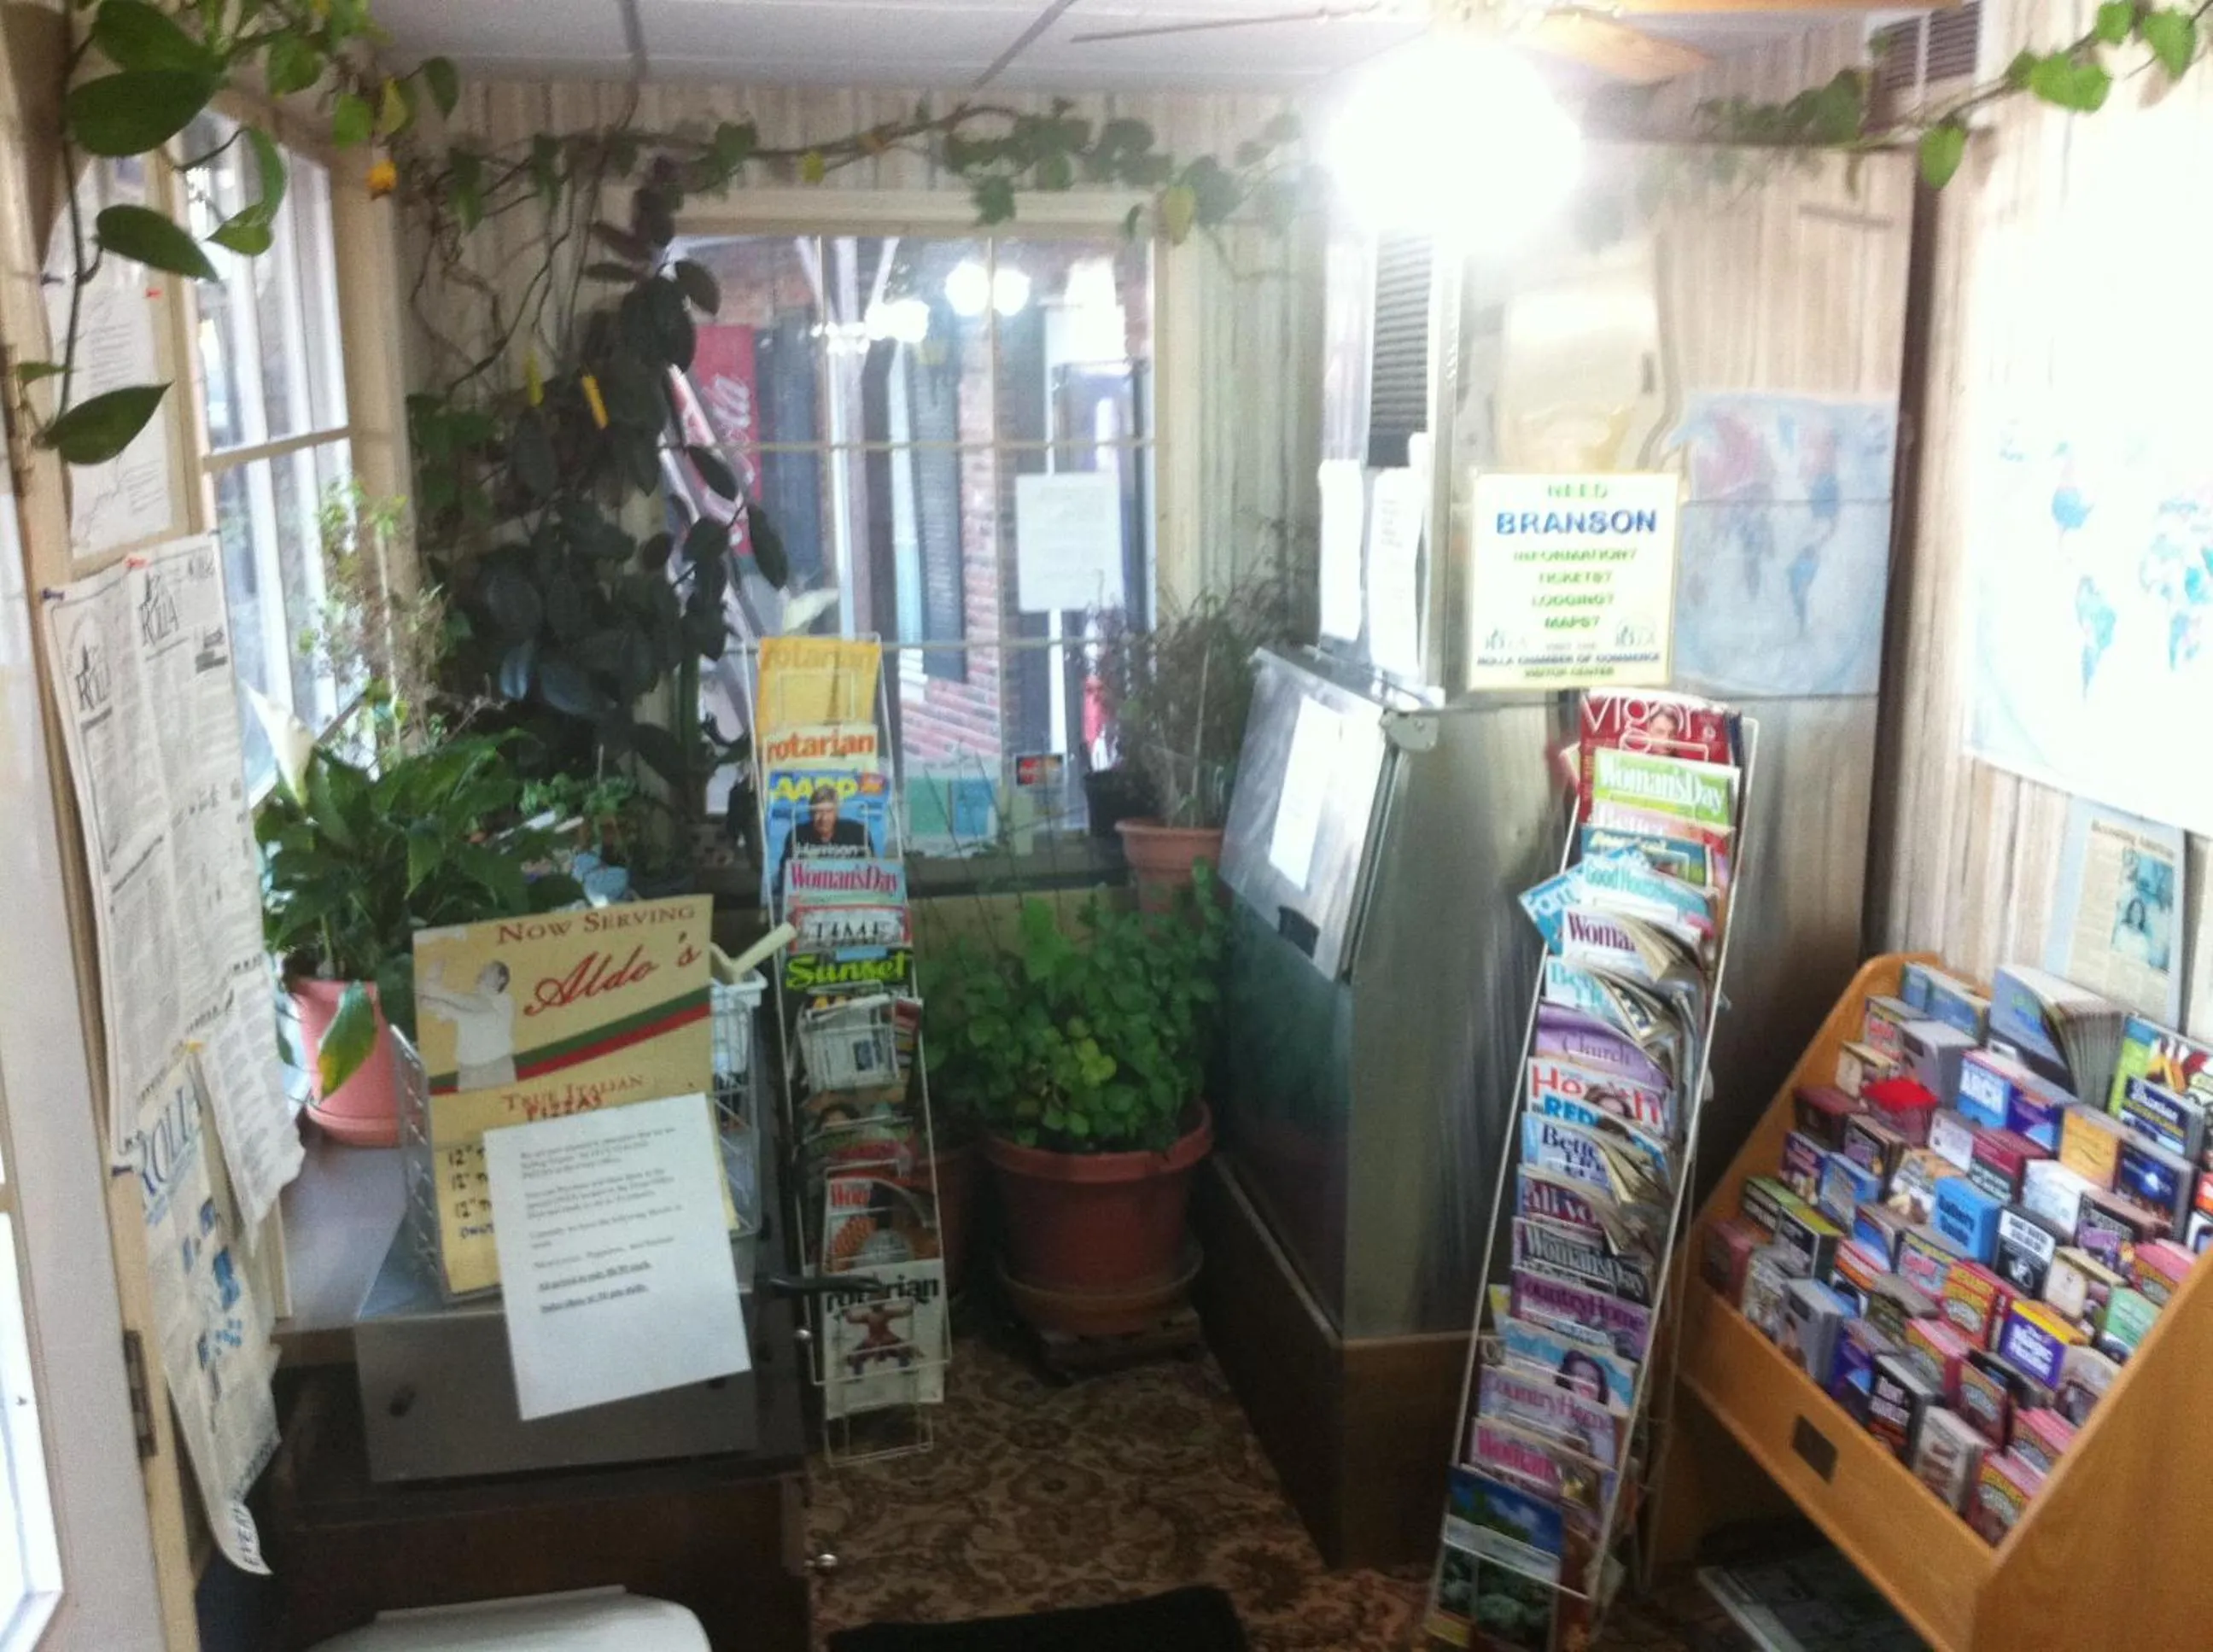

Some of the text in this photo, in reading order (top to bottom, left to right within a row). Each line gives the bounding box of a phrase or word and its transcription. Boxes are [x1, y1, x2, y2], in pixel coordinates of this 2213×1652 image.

[1496, 510, 1657, 535] BRANSON
[1576, 652, 1591, 663] OF
[768, 730, 874, 764] rotarian
[497, 903, 696, 945] NOW SERVING
[1568, 912, 1636, 951] Woma
[523, 931, 702, 1016] Aldo's
[785, 950, 905, 990] Sunset
[564, 1074, 643, 1106] ITALIAN
